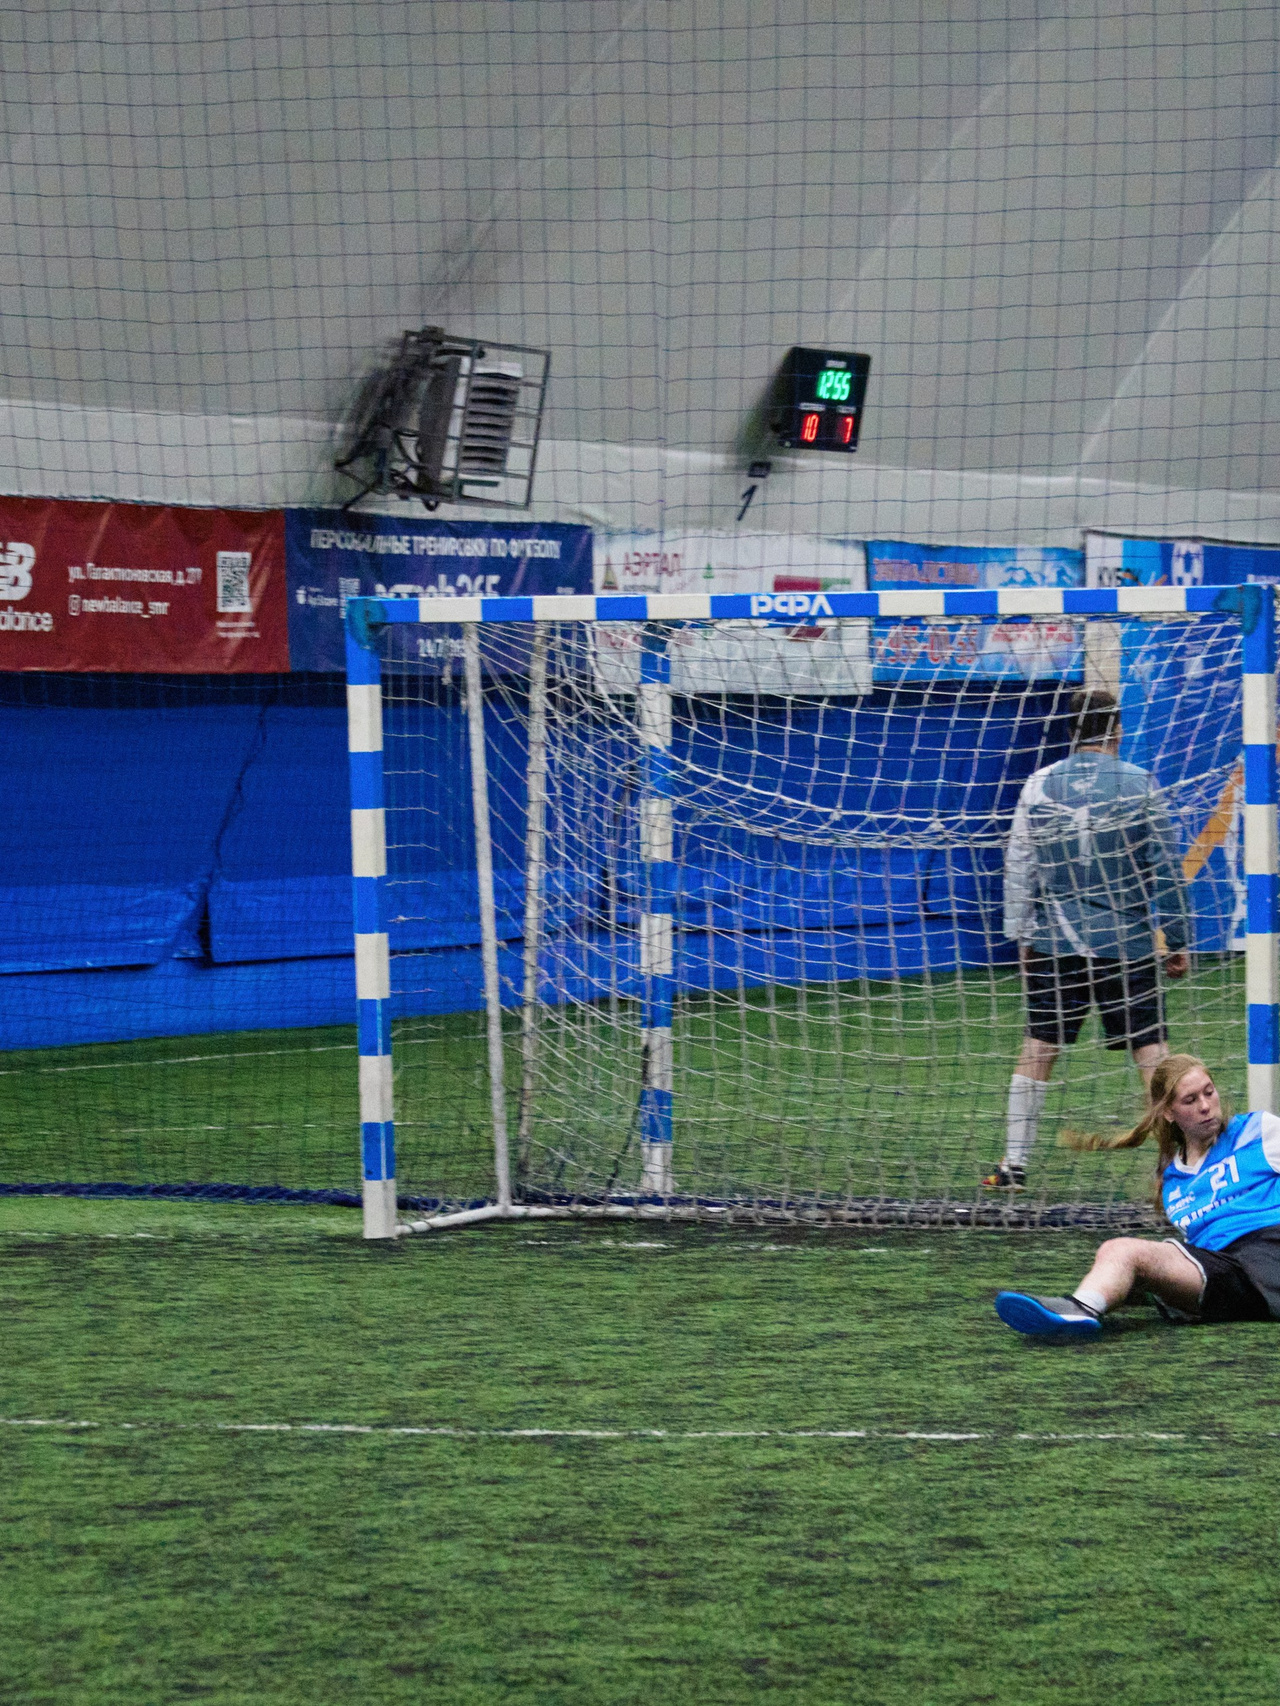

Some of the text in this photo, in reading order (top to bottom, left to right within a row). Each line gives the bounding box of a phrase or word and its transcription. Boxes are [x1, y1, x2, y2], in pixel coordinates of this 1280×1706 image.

[802, 414, 854, 443] 10 7
[1208, 1154, 1240, 1191] 21
